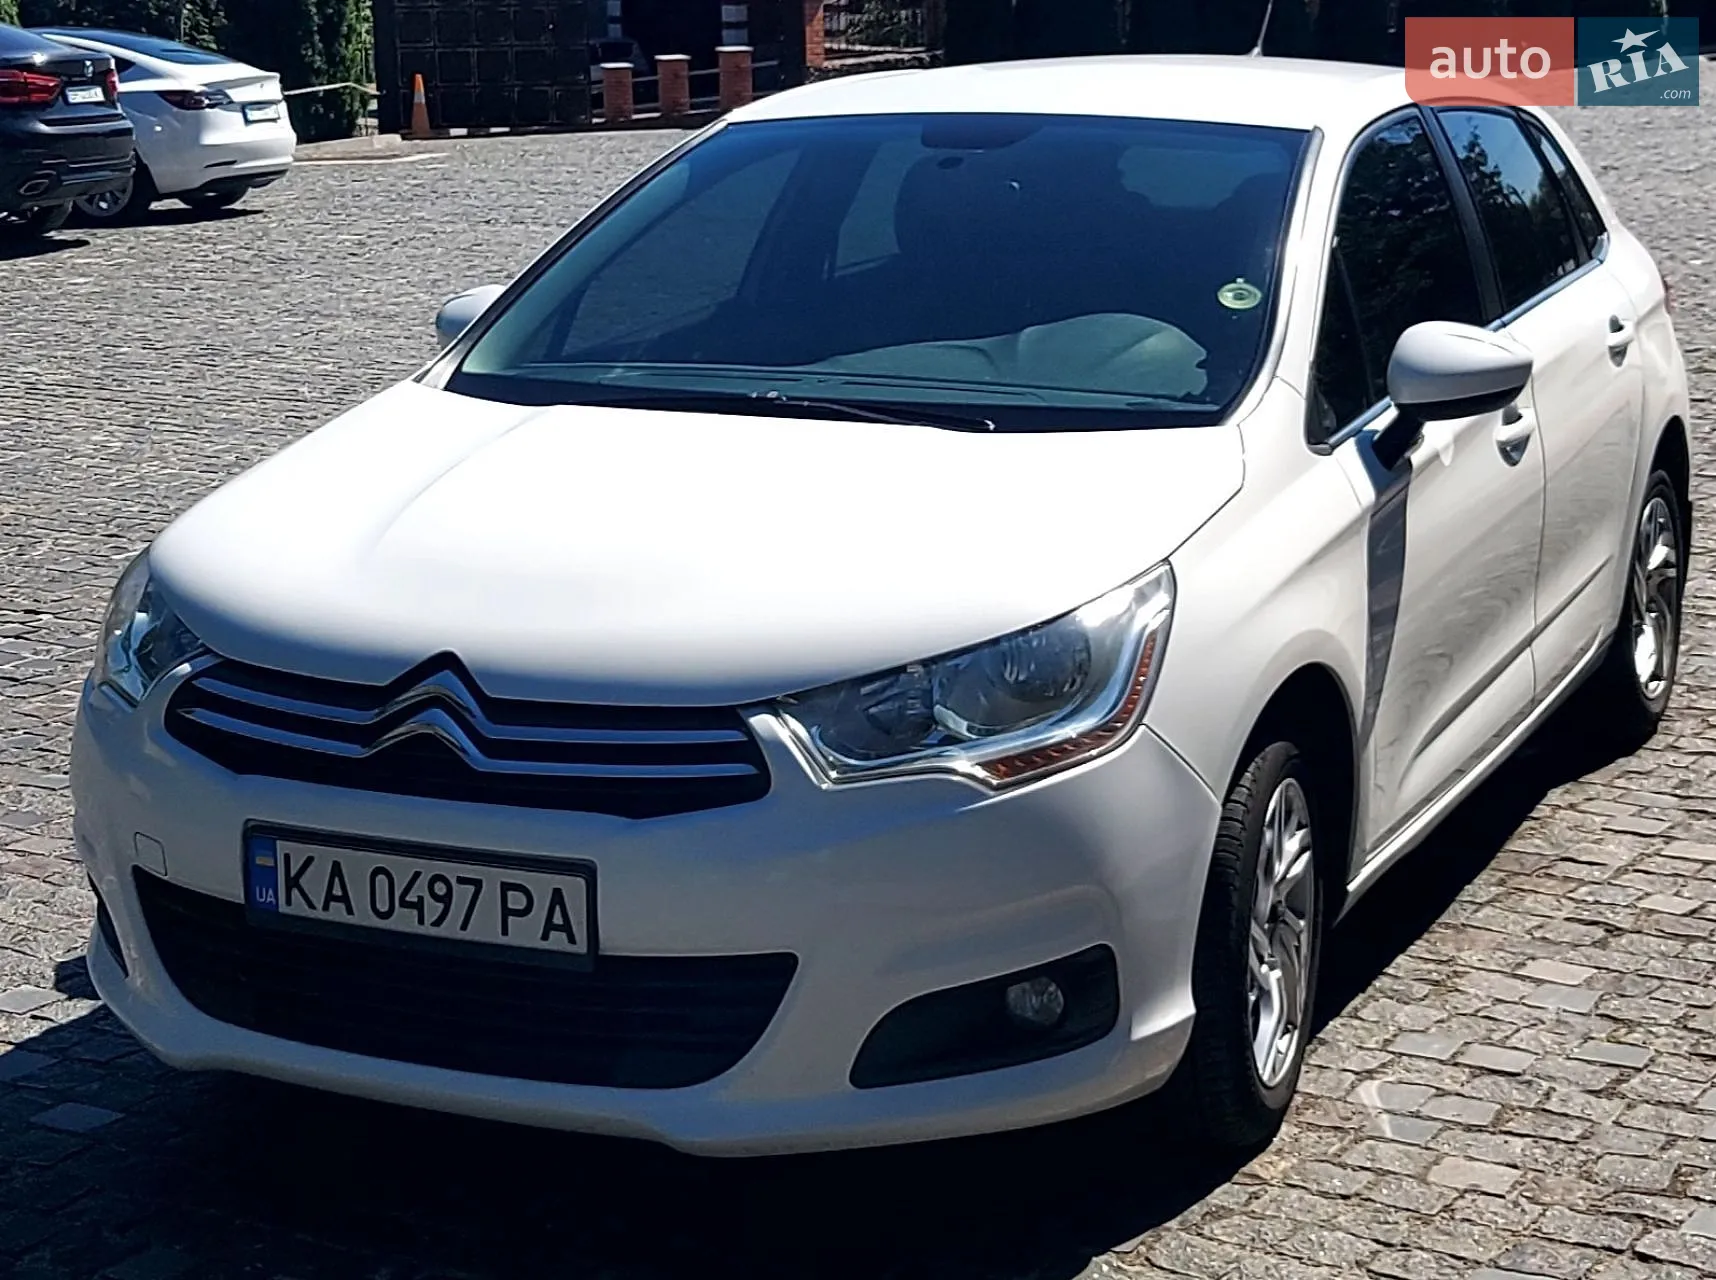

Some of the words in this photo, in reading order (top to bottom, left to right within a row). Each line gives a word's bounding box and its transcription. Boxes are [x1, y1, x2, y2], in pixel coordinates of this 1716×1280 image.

[255, 885, 276, 905] UA
[283, 852, 355, 916] KA
[369, 865, 484, 931] 0497
[500, 880, 578, 945] PA
